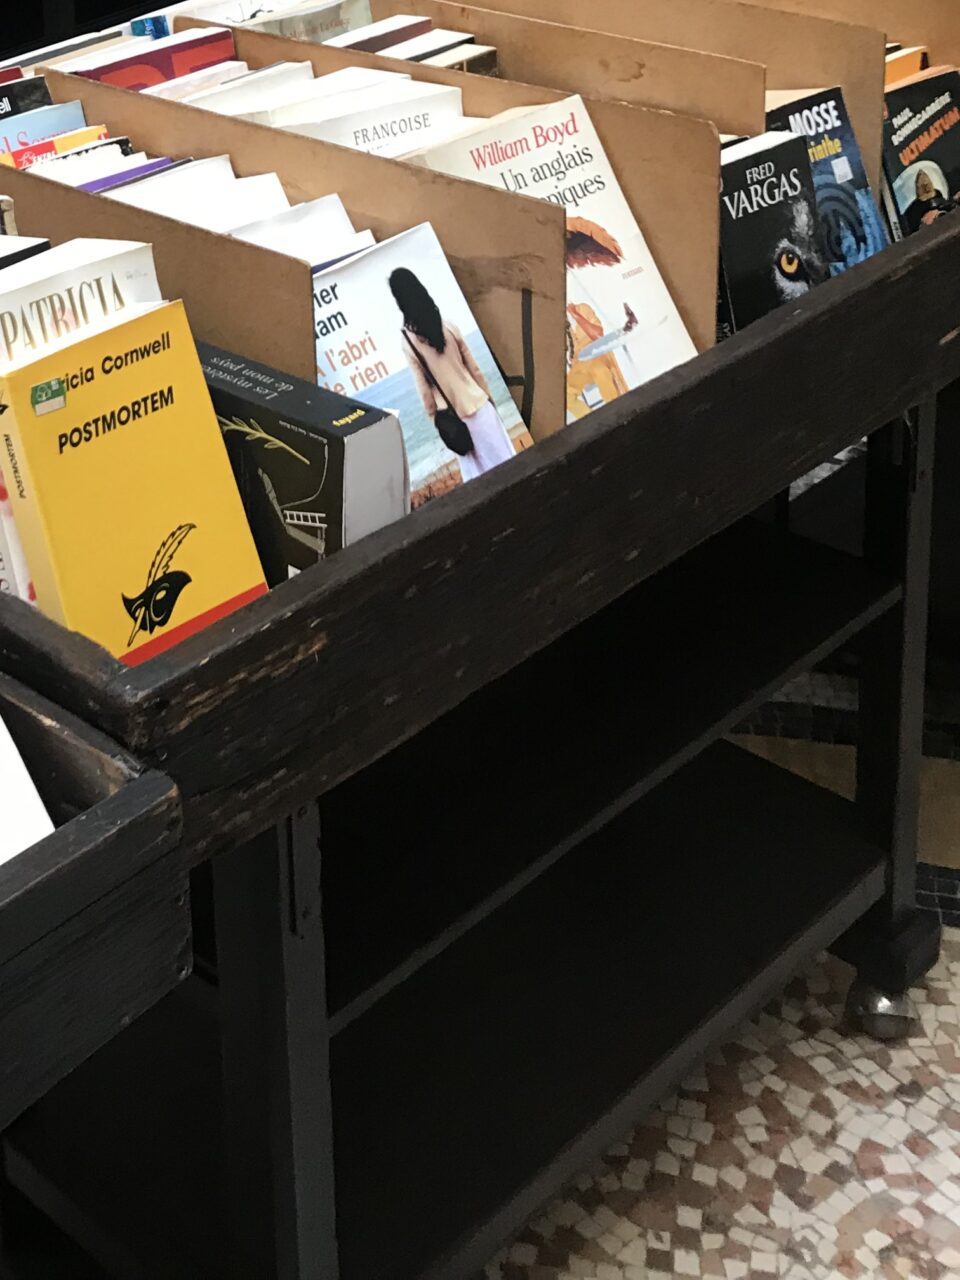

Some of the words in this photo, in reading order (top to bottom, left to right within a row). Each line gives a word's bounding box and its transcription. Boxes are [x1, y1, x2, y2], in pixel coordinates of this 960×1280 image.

[353, 112, 432, 147] FRANÇOISE
[788, 100, 843, 137] MOSSE
[469, 136, 533, 173] William
[533, 112, 581, 152] Boyd
[499, 168, 529, 194] Un
[531, 144, 595, 184] anglais
[745, 161, 775, 185] FRED
[722, 167, 803, 220] VARGAS
[101, 331, 171, 376] Cornwell
[210, 356, 245, 373] pays
[324, 331, 378, 370] l'abri
[242, 367, 275, 385] mon
[254, 386, 279, 401] Les
[275, 381, 294, 393] de
[349, 359, 390, 395] rien
[57, 386, 176, 455] POSTMORTEM
[332, 408, 366, 428] fayard
[3, 433, 27, 500] POSTMORTEM
